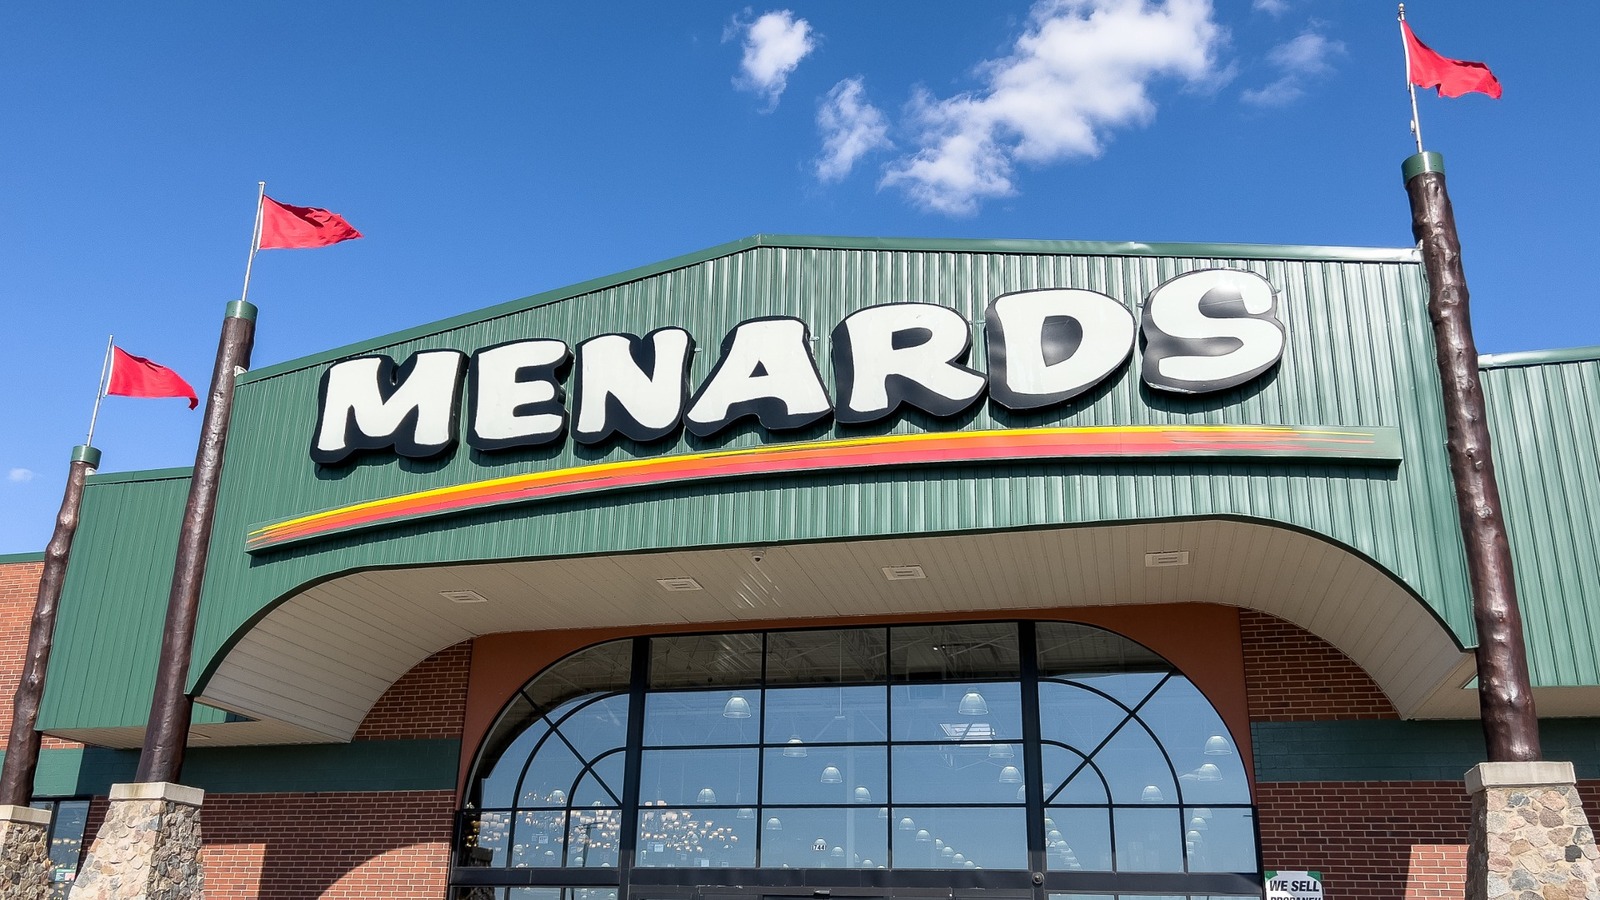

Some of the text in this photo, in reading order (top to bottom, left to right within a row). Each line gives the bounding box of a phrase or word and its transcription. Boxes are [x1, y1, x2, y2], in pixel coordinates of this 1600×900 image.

[311, 268, 1285, 462] MENARDS
[1269, 880, 1320, 892] WE SELL
